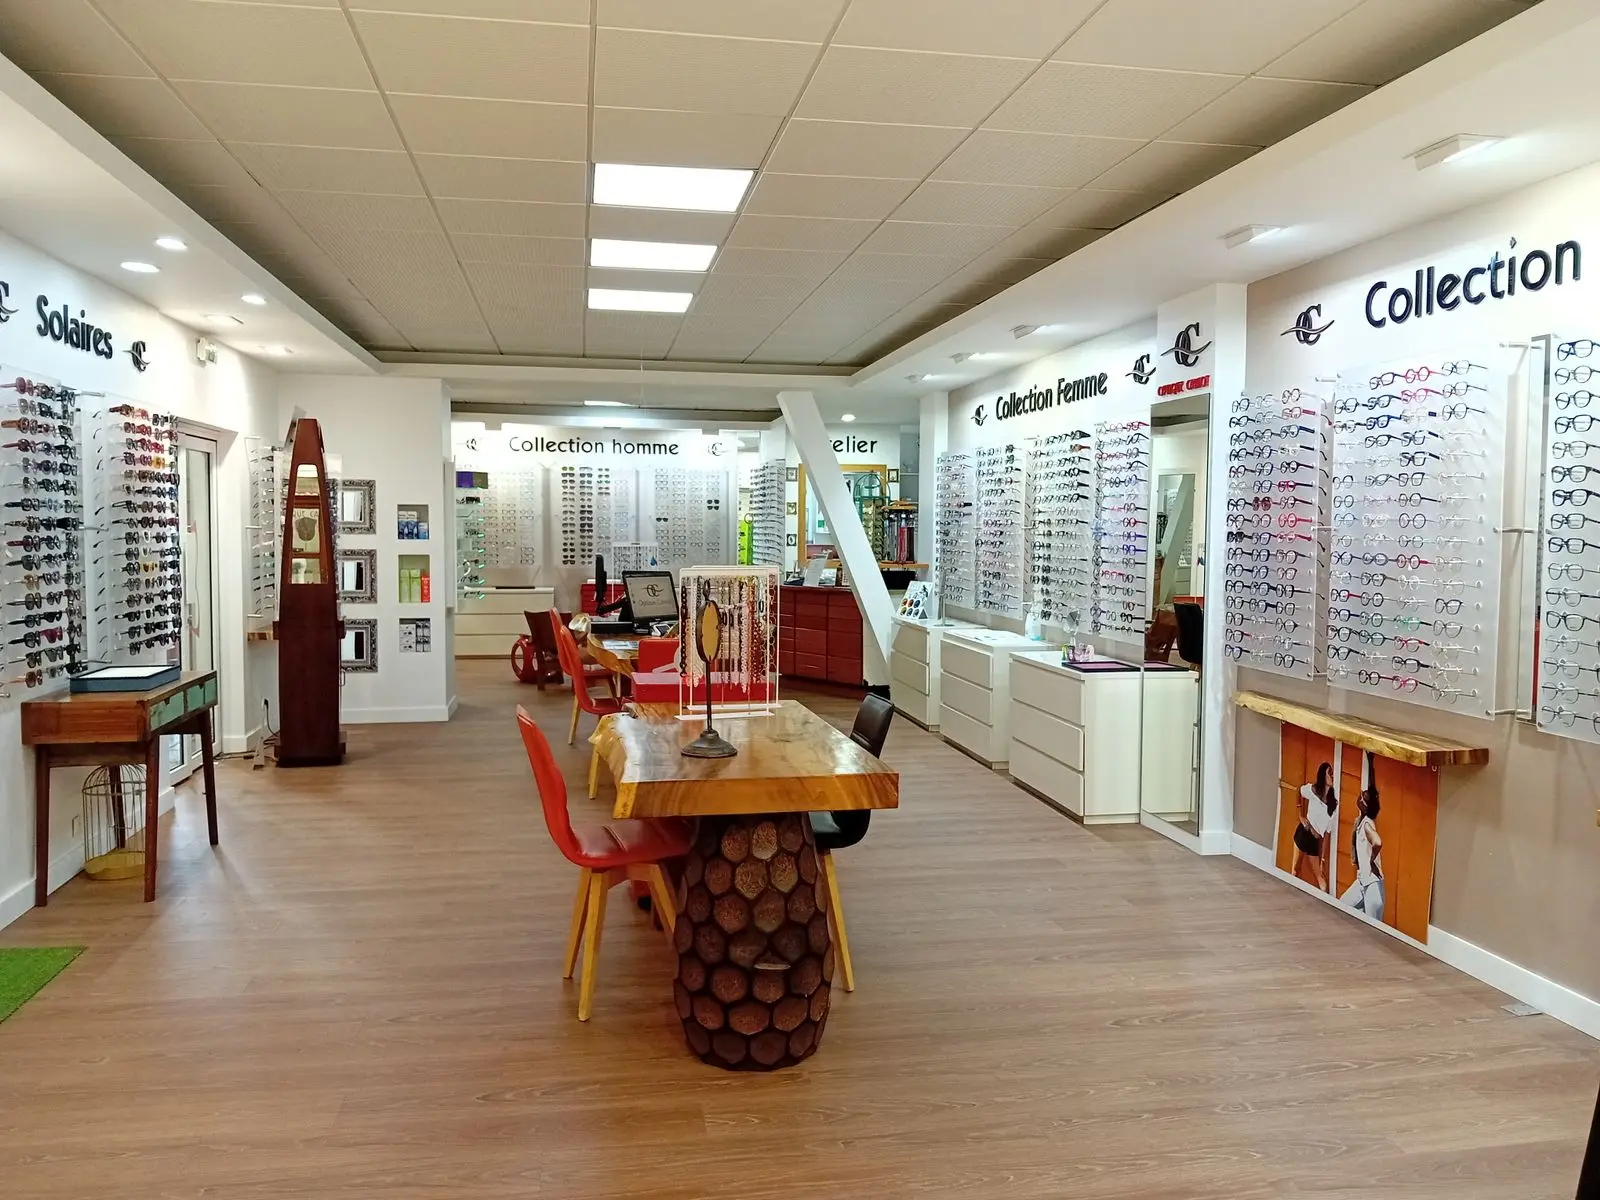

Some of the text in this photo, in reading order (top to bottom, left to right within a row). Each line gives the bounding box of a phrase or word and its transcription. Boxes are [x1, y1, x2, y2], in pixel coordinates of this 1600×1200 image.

[1365, 237, 1582, 329] Collection
[36, 294, 113, 360] Solaires
[995, 372, 1108, 421] Collection Femme
[509, 436, 679, 455] Collection homme
[829, 435, 878, 453] elier
